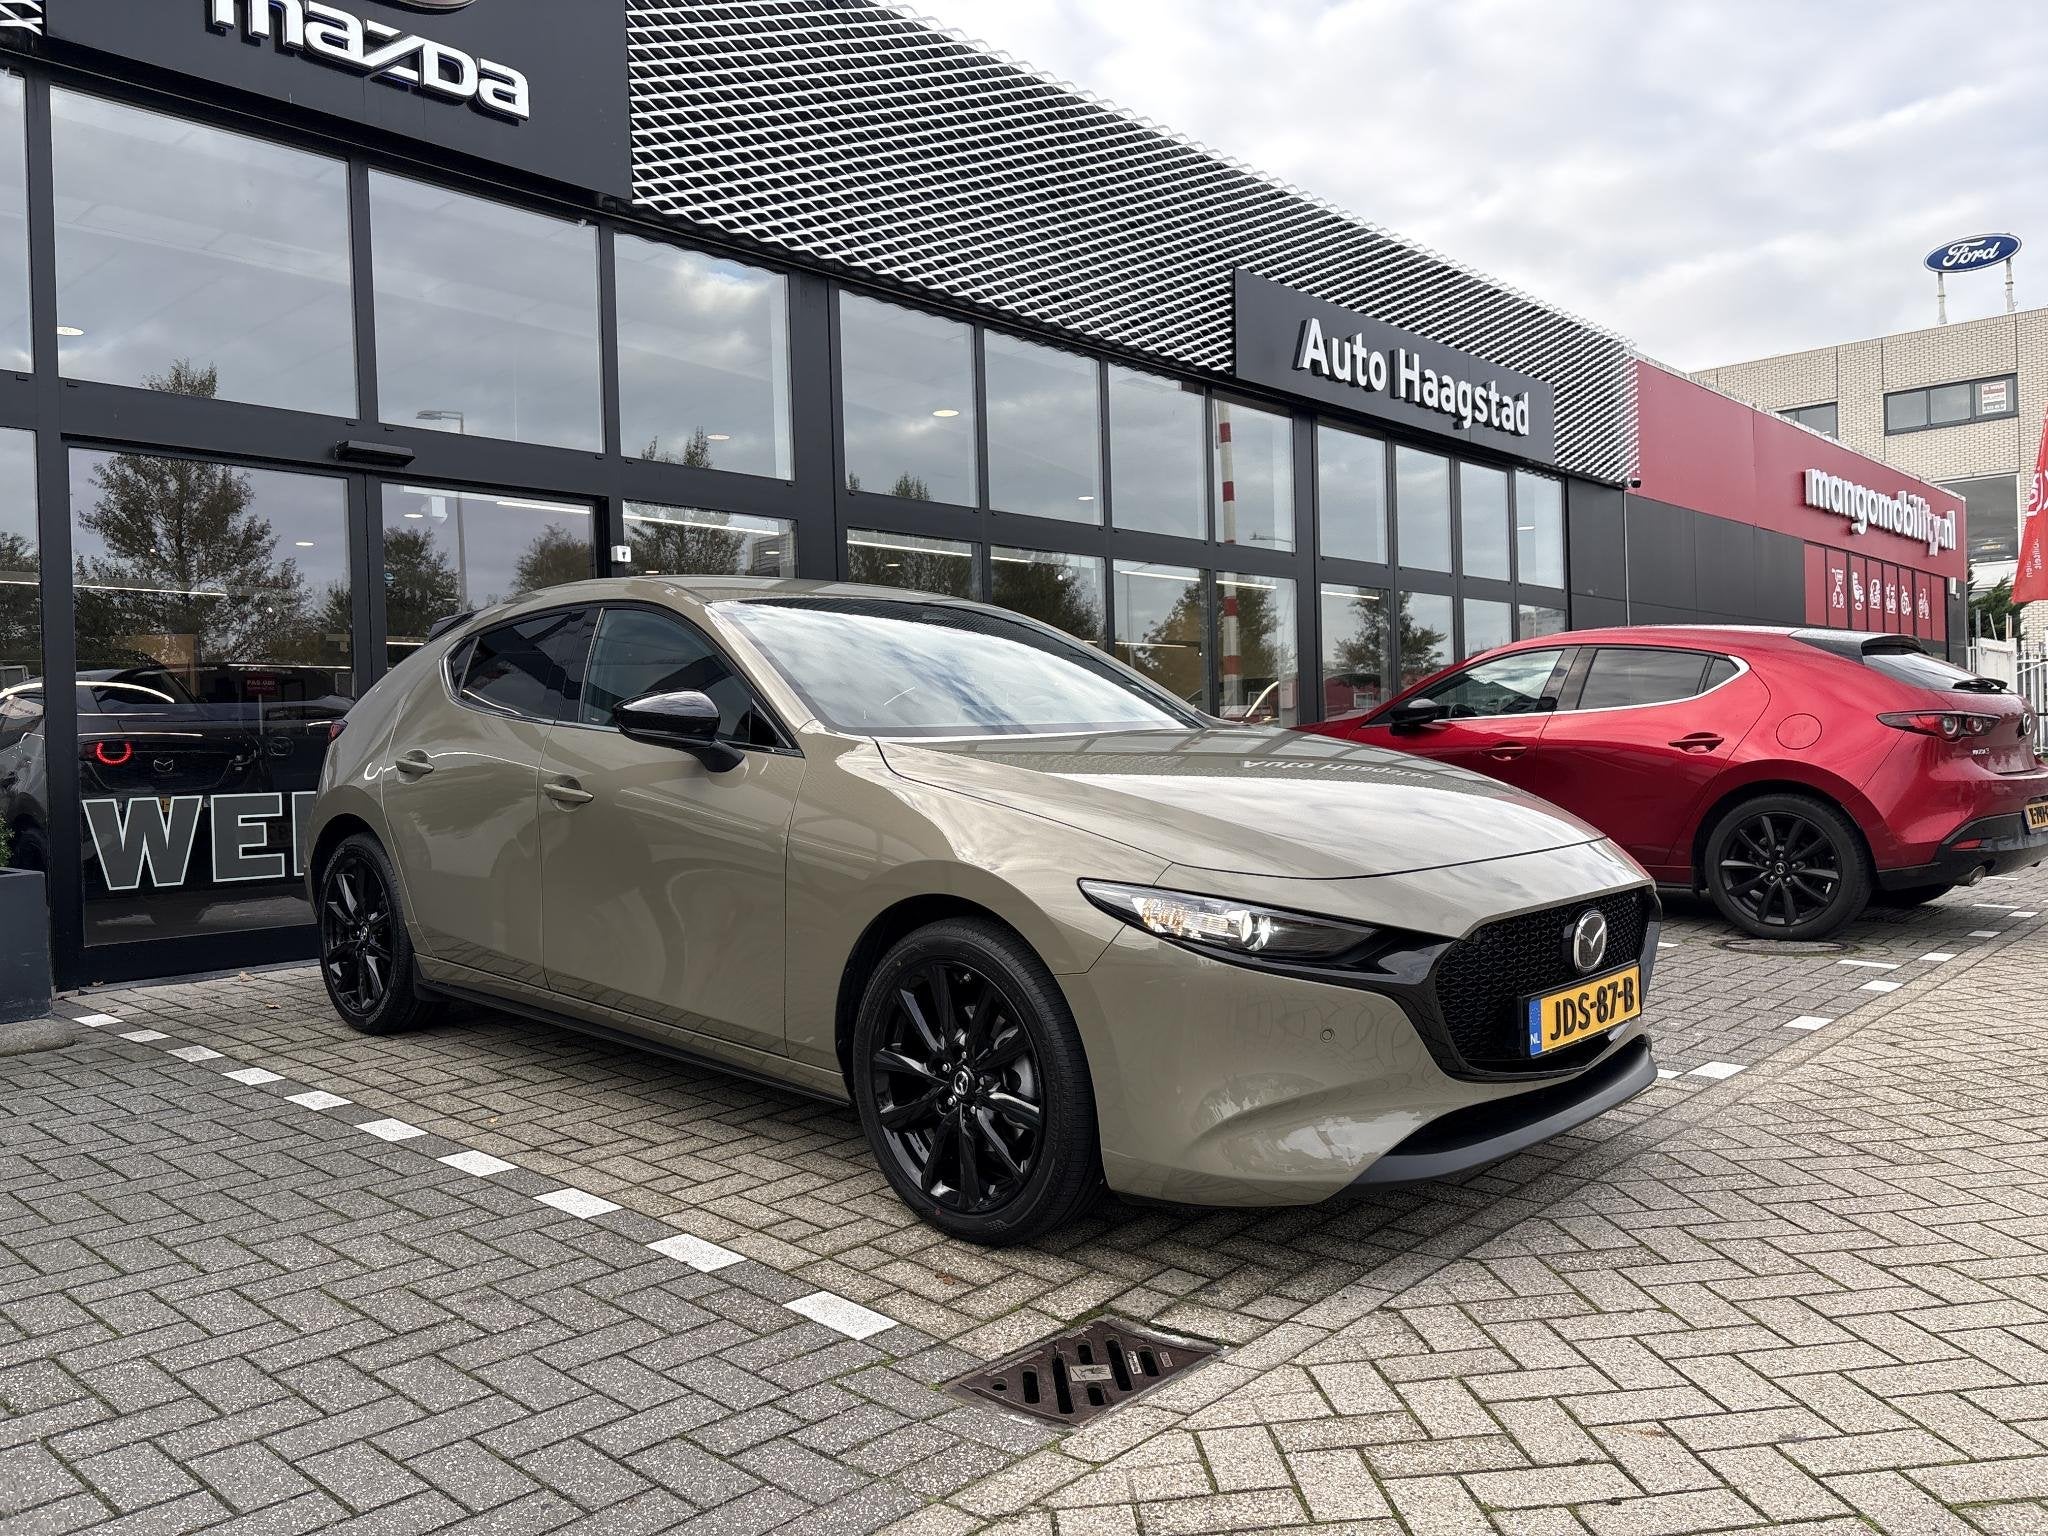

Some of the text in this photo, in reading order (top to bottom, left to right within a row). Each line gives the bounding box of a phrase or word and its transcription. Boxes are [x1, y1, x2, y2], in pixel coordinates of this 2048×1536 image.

[1942, 240, 2001, 267] Ford
[1297, 318, 1529, 436] Auto Haagstad
[1805, 468, 1957, 557] mangomobility.nl
[1530, 1032, 1541, 1046] NL
[1550, 976, 1635, 1041] JDS-87-B
